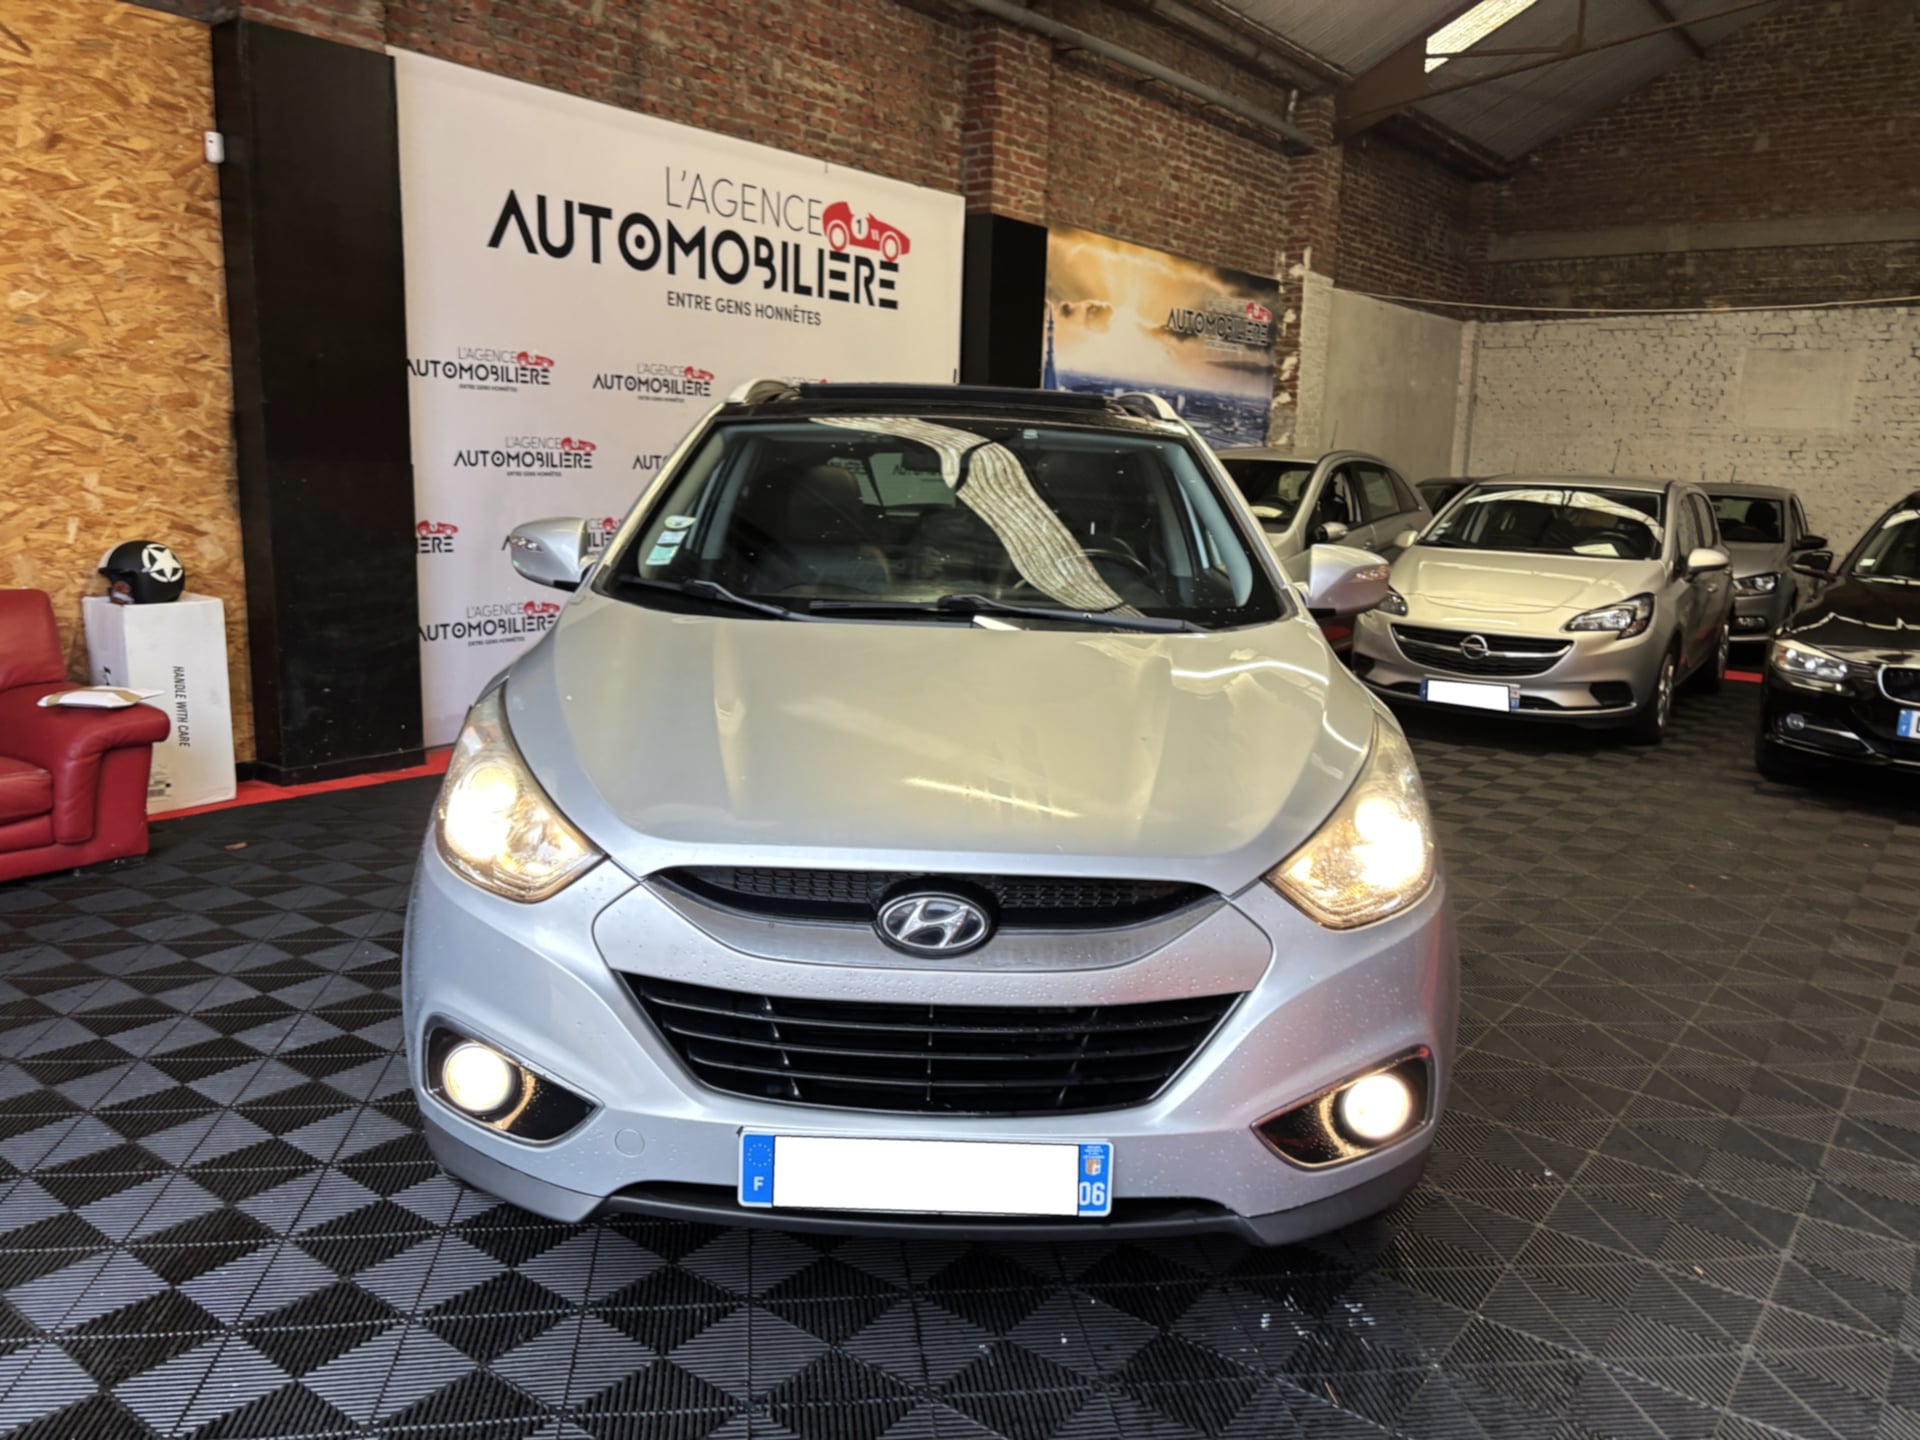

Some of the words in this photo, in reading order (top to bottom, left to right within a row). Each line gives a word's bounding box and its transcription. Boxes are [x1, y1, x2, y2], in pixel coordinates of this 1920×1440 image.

[666, 166, 823, 236] L'AGENCE
[666, 290, 712, 311] ENTRE
[715, 298, 752, 317] GENS
[755, 303, 822, 327] HONNÊTES
[1166, 307, 1268, 346] AUTOMOBERE
[173, 666, 187, 699] HANDLE
[176, 701, 189, 723] WITH
[178, 724, 191, 747] CARE
[753, 1176, 764, 1191] F
[1079, 1181, 1106, 1206] 06
